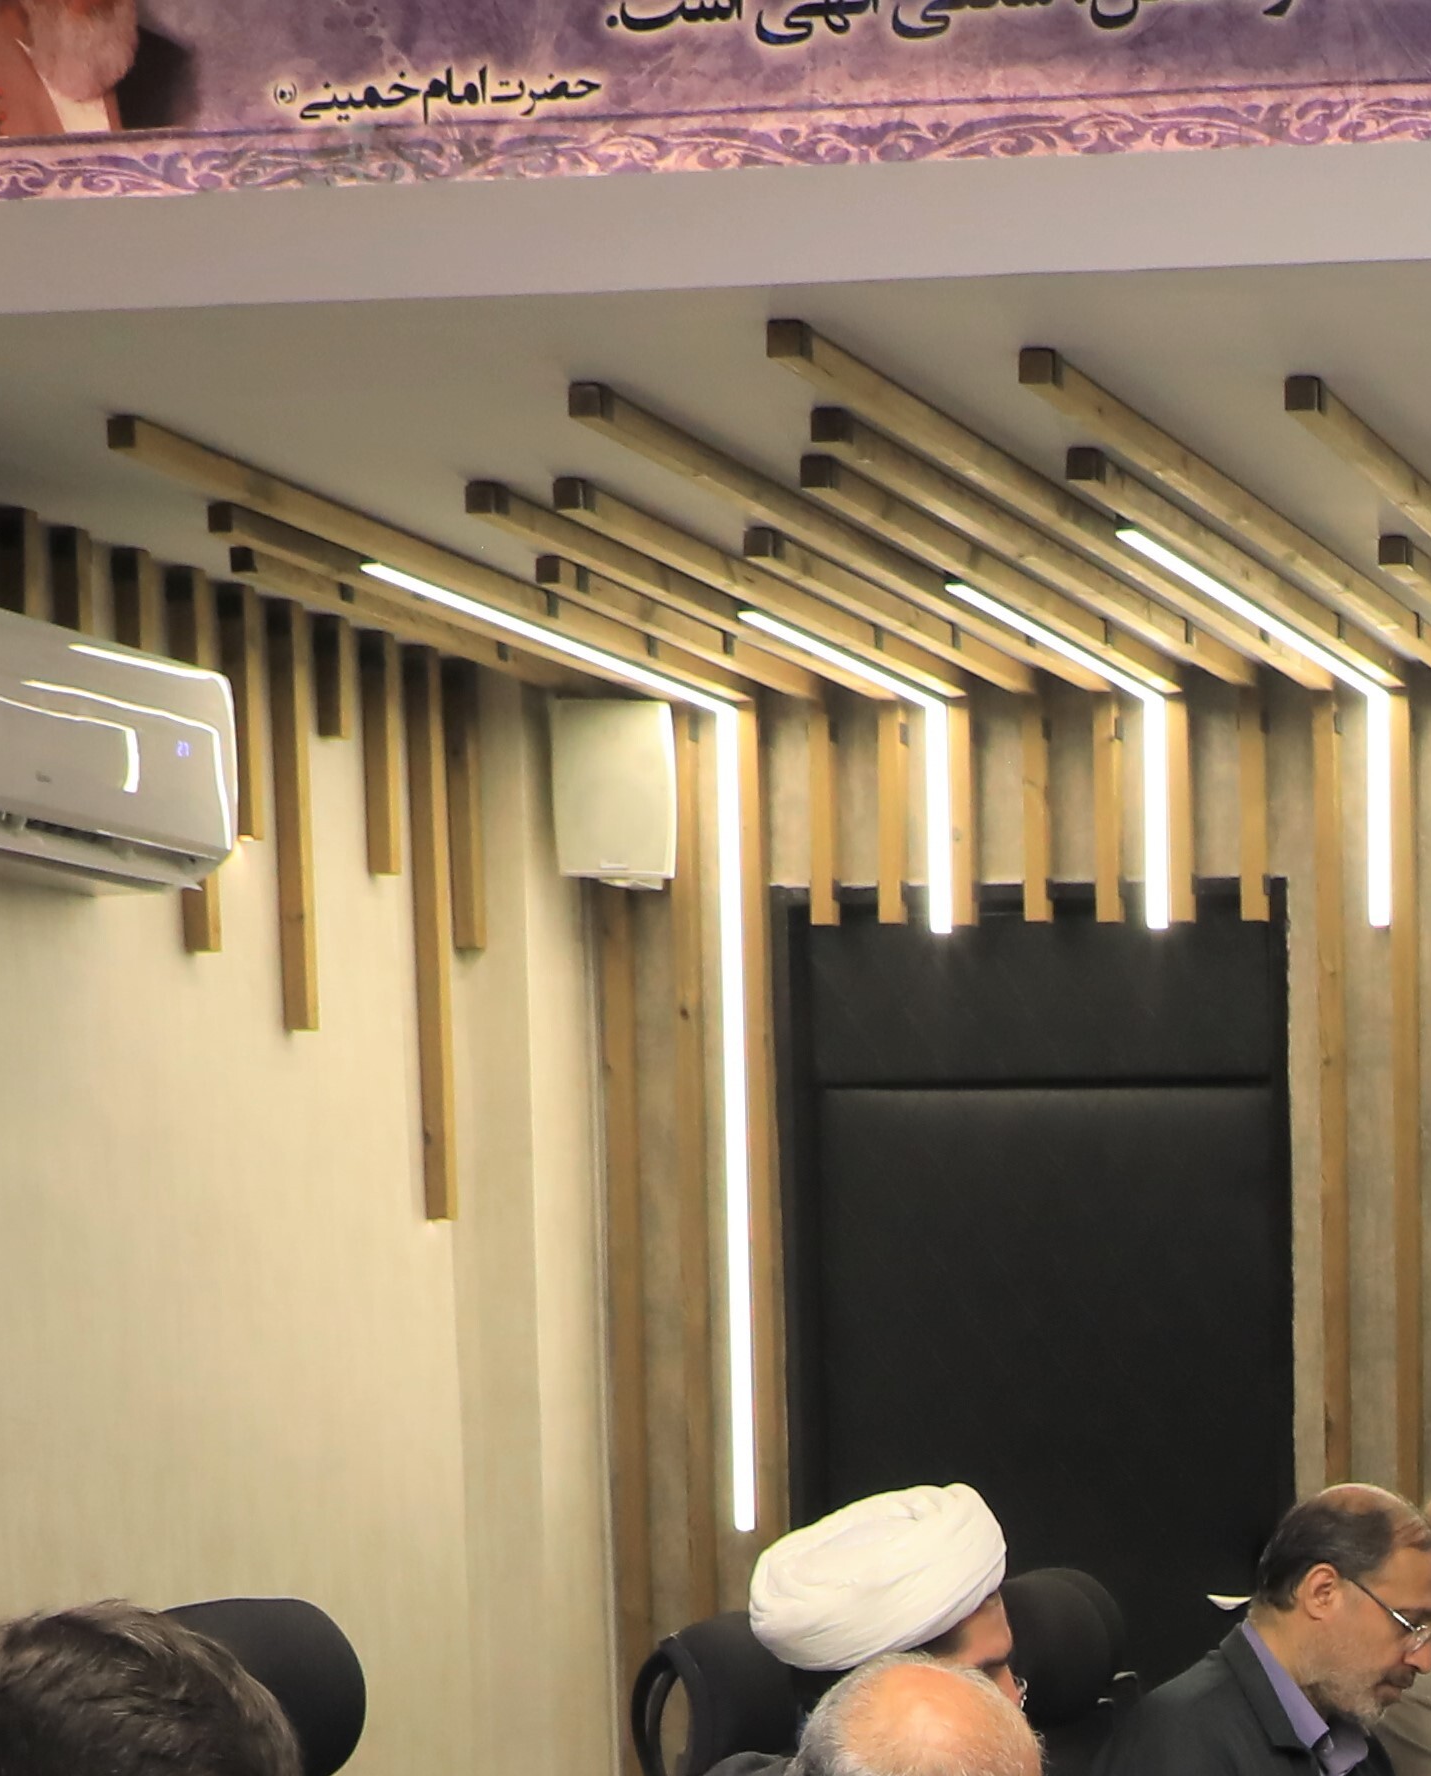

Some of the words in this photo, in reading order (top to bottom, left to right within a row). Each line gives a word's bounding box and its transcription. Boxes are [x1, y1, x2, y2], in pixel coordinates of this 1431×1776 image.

[299, 71, 421, 121] خمینی
[423, 64, 488, 125] امام
[490, 72, 602, 117] حضرت
